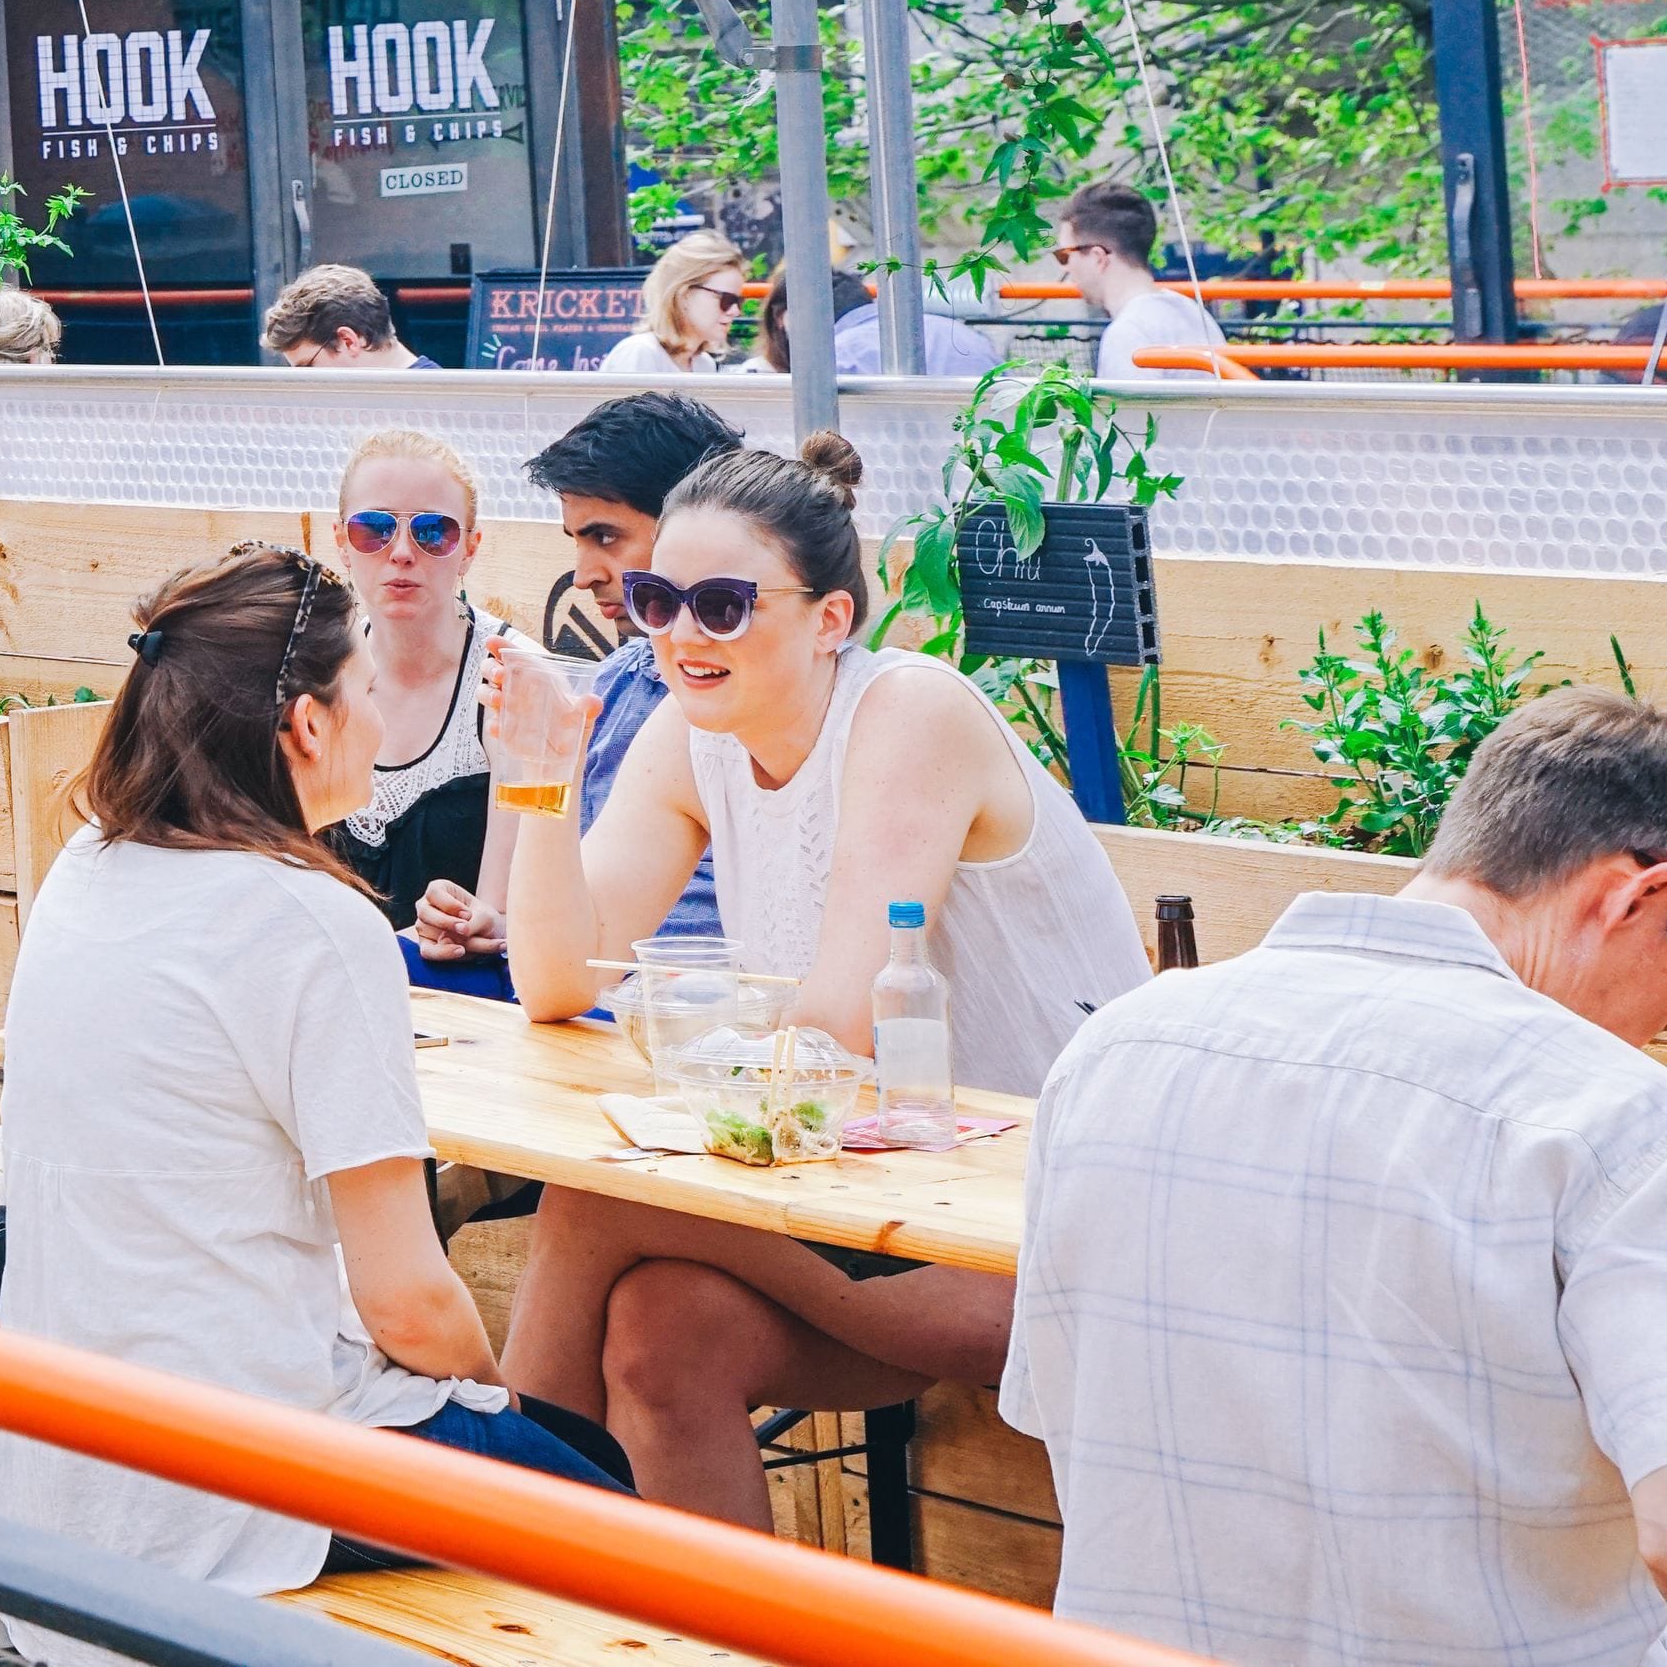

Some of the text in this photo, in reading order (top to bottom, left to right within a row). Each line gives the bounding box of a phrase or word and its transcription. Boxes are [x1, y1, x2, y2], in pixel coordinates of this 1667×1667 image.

[37, 29, 216, 127] HOOK
[328, 18, 500, 115] HOOK
[42, 133, 218, 159] FISH & CHIPS
[334, 120, 502, 146] FISH & CHIPS
[386, 170, 463, 190] CLOSED
[983, 597, 1031, 618] Capsicum
